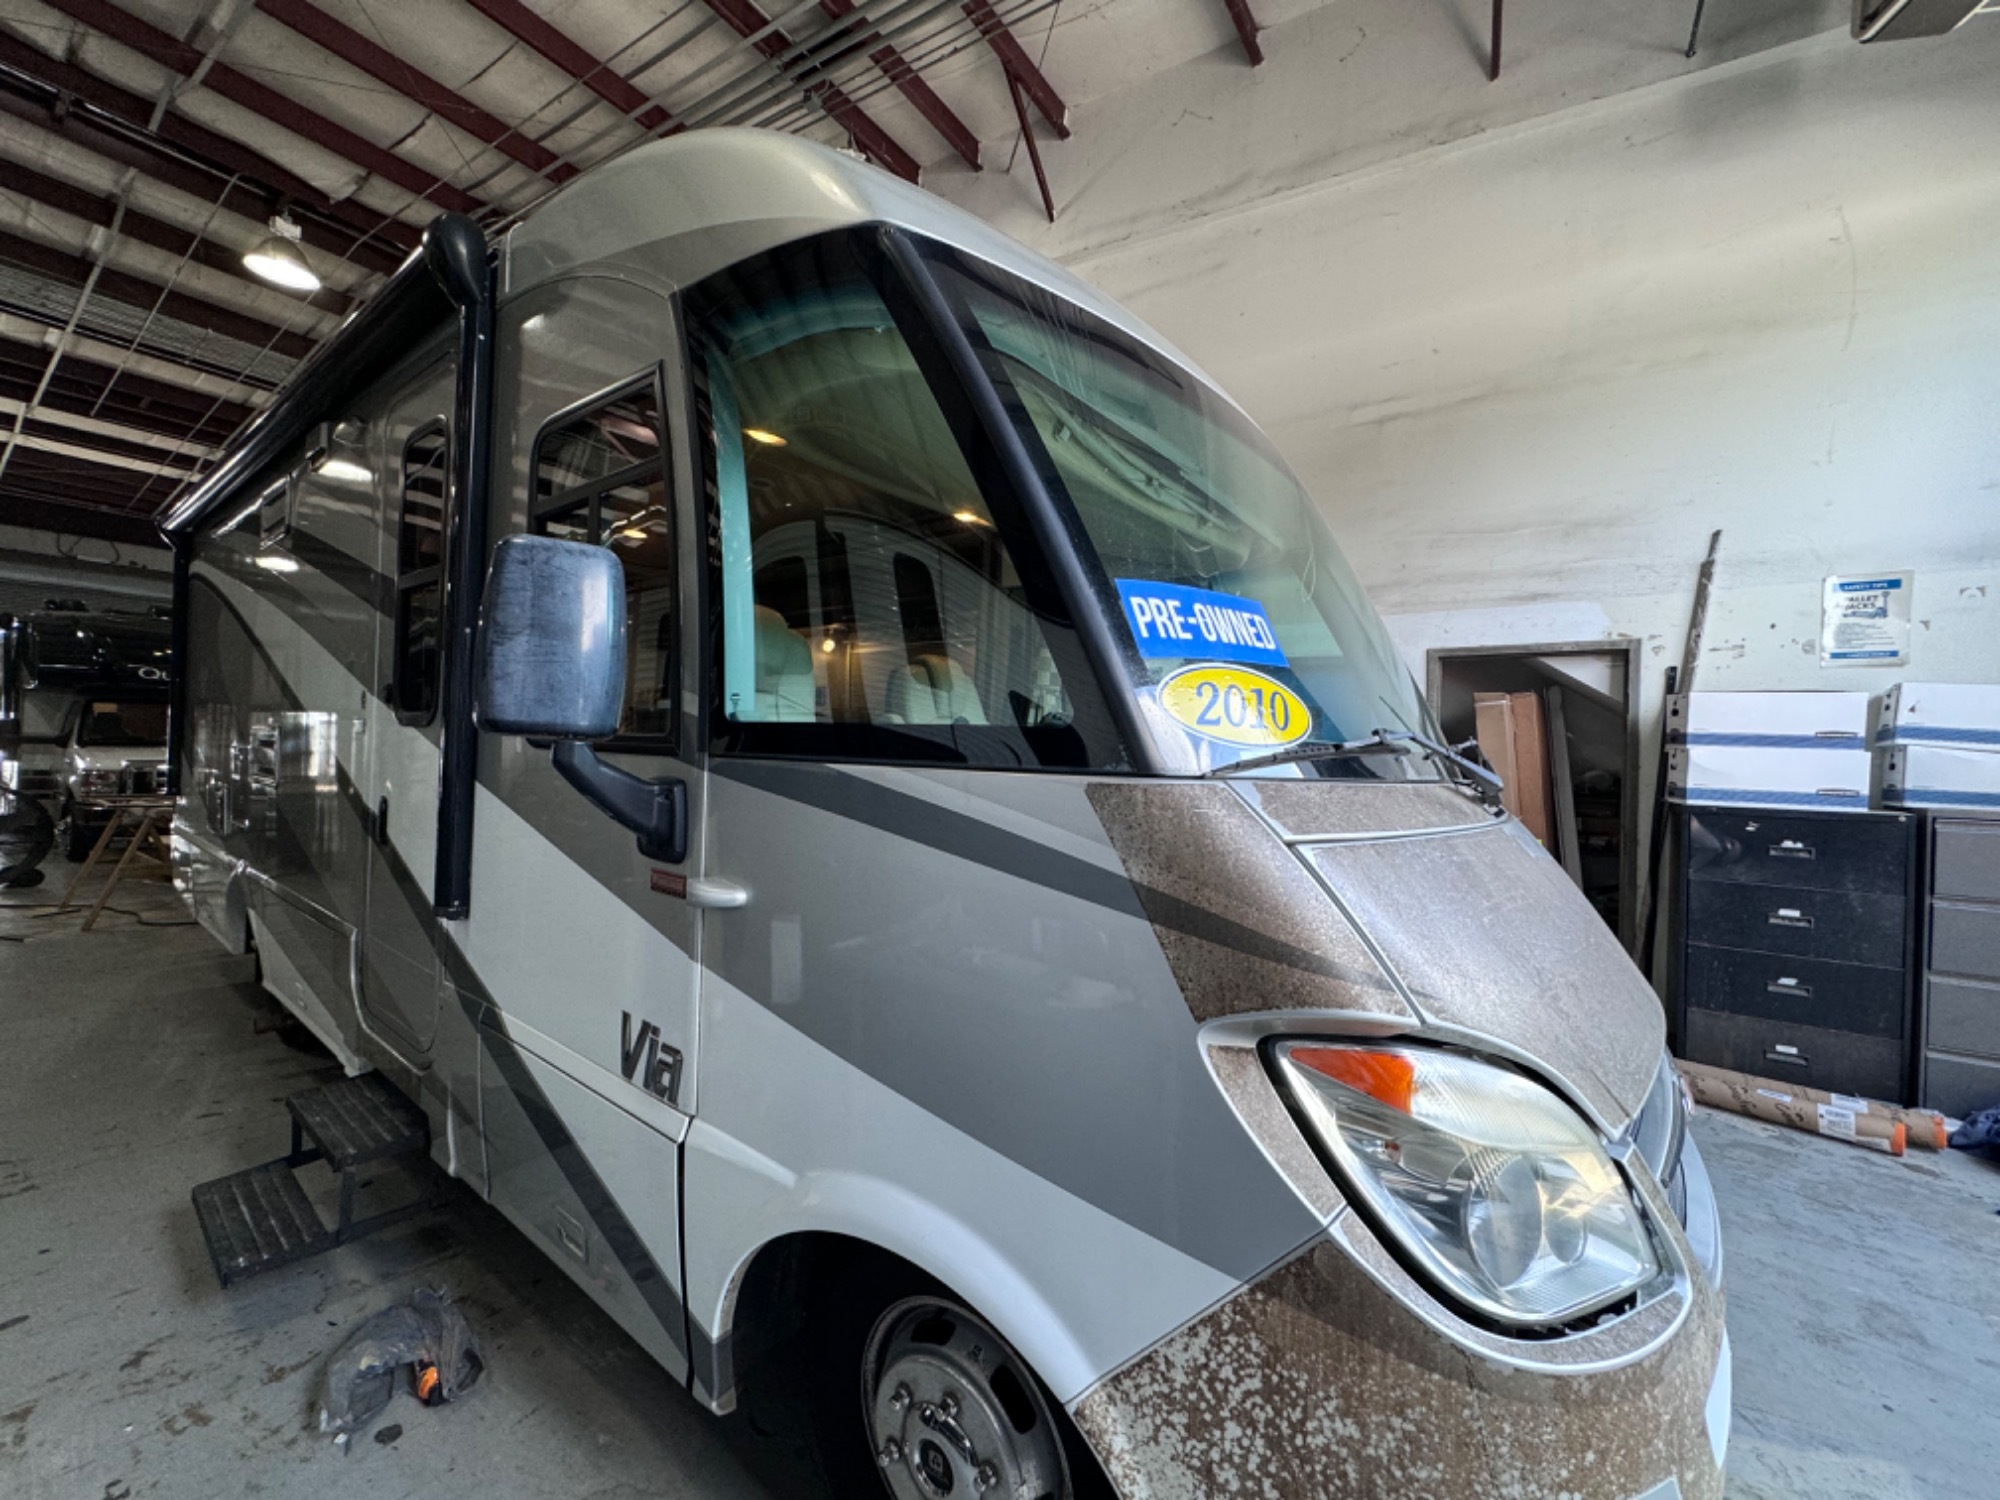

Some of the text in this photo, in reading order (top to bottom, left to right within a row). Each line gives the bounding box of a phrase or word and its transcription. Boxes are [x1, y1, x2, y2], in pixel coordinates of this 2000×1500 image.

[1129, 597, 1276, 650] PRE-OWNED
[1196, 682, 1290, 731] 2010
[621, 1010, 683, 1108] Via
